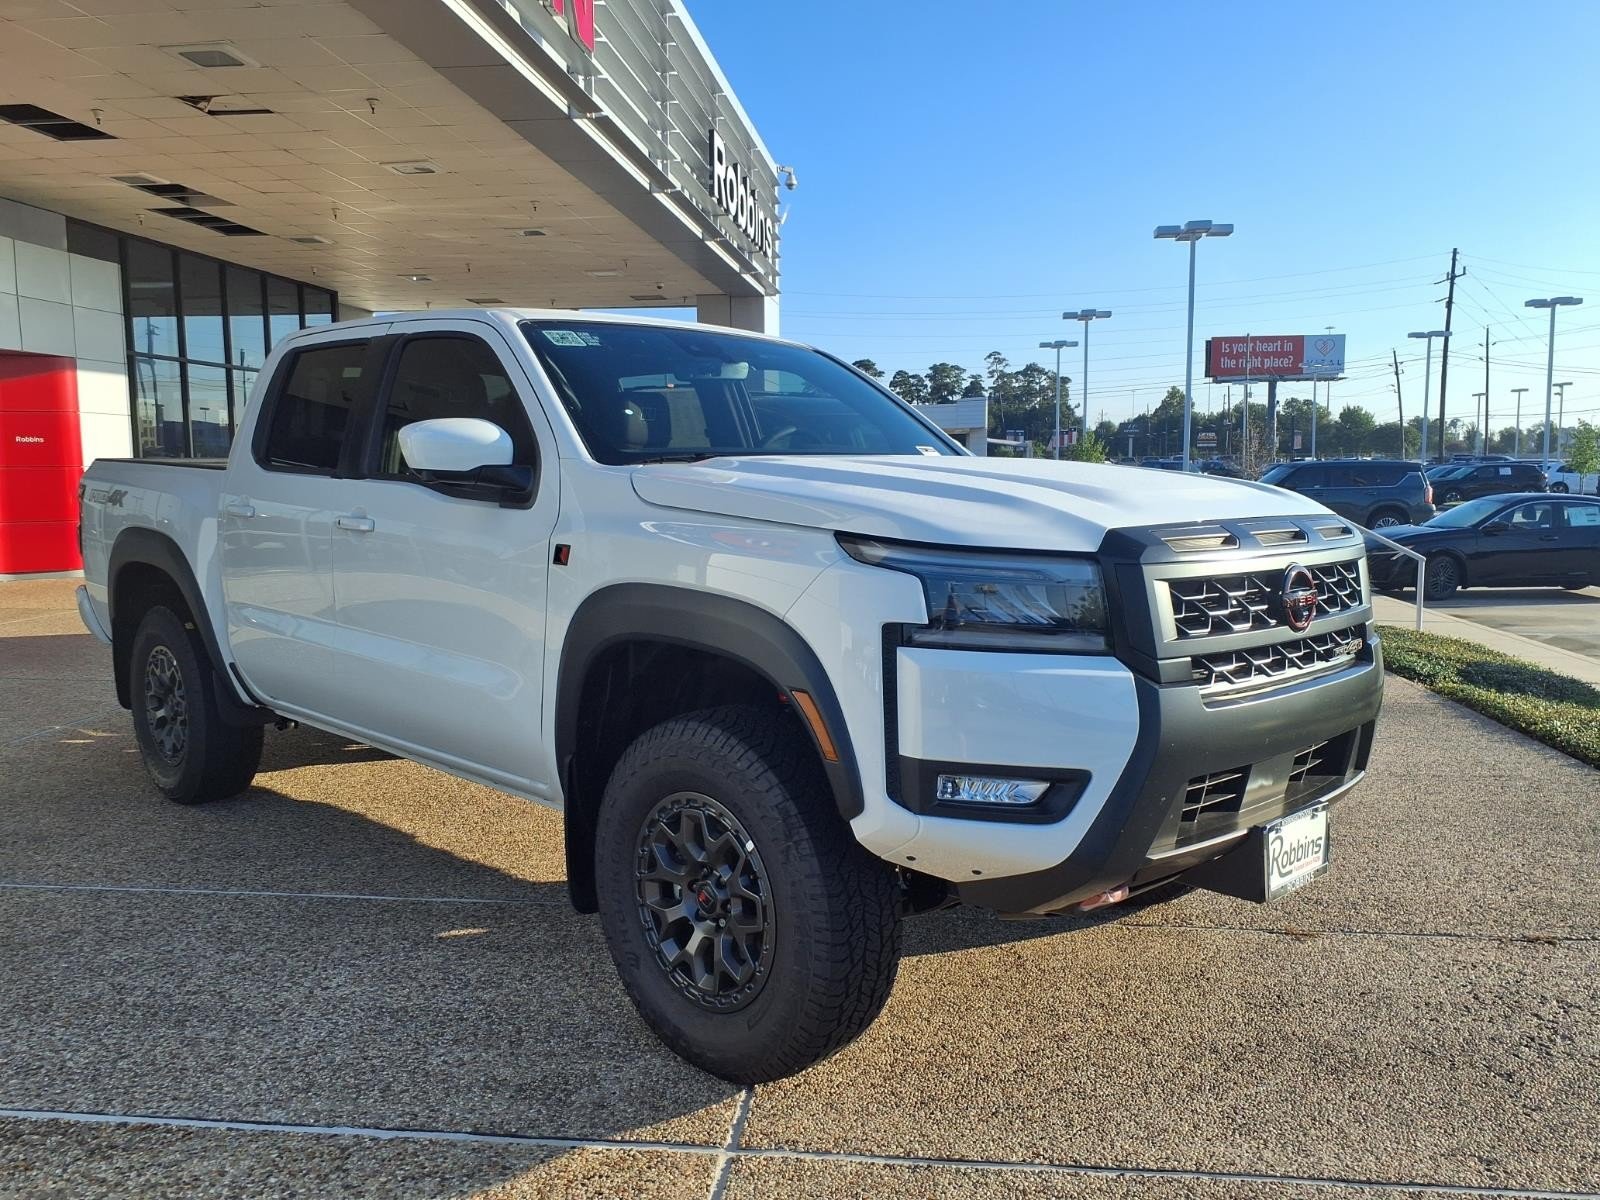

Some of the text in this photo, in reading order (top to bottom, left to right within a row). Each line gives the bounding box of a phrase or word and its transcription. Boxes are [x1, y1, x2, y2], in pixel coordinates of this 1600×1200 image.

[709, 129, 773, 258] Robbins
[1221, 341, 1230, 353] Is
[1256, 340, 1281, 352] heart
[1284, 340, 1293, 352] in
[1220, 356, 1236, 368] the
[1264, 355, 1294, 369] place?
[15, 435, 45, 443] Robbins
[1270, 835, 1323, 879] Robbins
